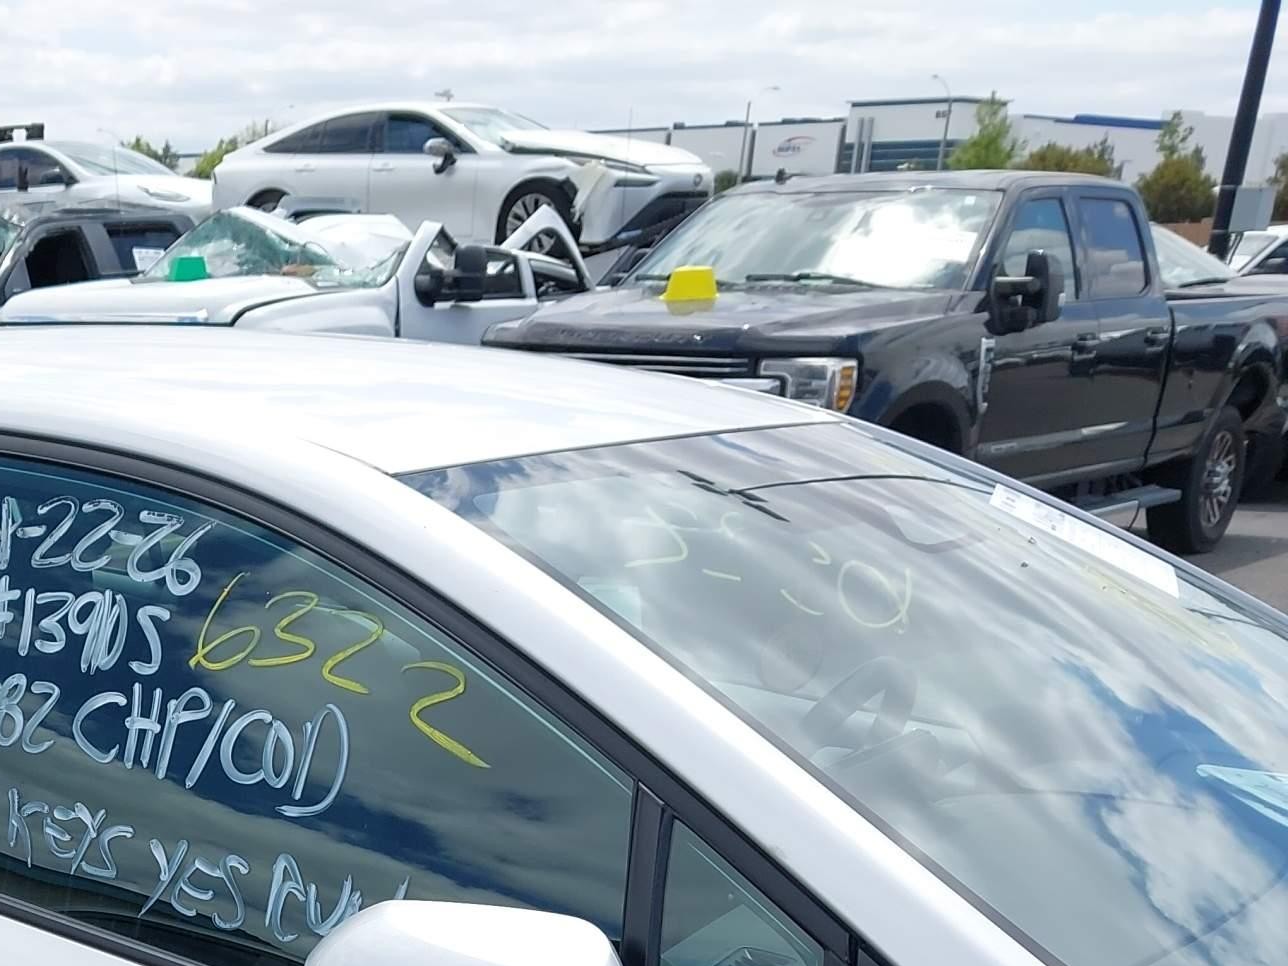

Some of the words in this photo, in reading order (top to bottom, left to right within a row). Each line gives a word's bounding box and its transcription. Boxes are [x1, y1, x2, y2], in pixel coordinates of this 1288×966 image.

[188, 571, 492, 769] 6322
[8, 787, 135, 876] KEYS
[137, 838, 250, 930] YES
